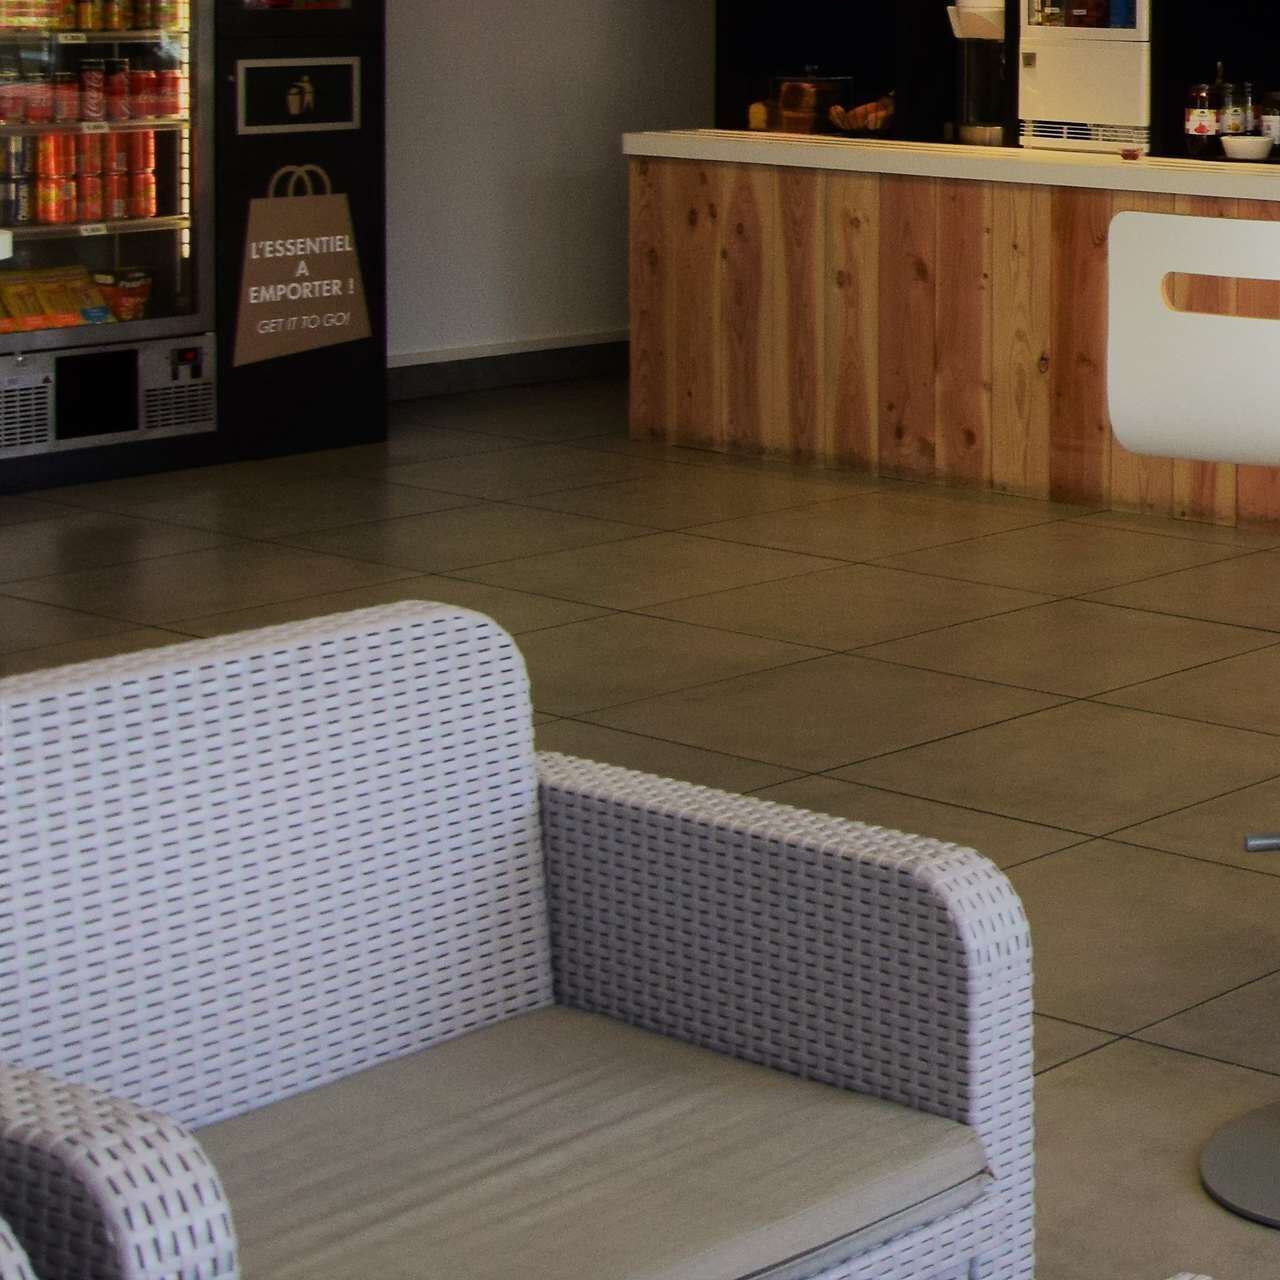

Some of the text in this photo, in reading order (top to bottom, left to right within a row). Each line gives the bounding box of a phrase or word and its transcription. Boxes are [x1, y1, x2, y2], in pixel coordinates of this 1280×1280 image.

[250, 234, 353, 259] L'ESSENTIEL
[294, 259, 309, 277] A
[249, 278, 355, 304] EMPORTER !
[257, 312, 351, 335] GET IT TO GO!
